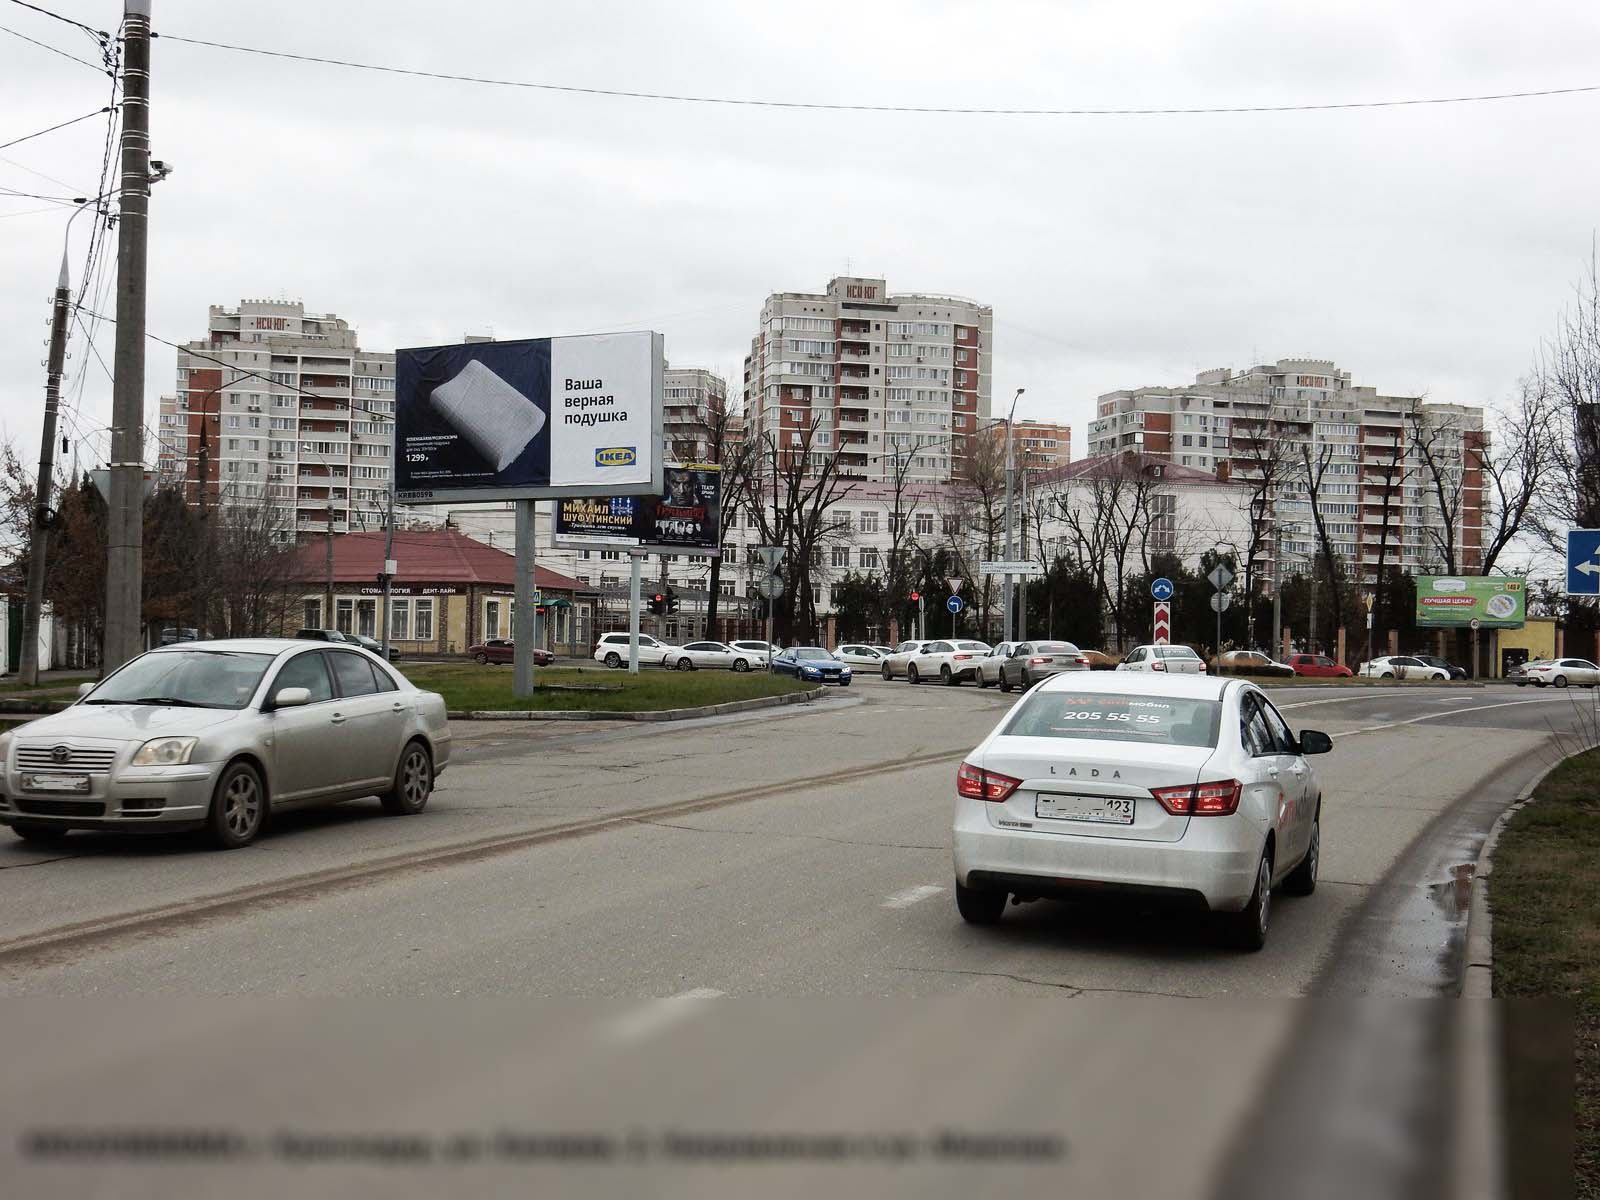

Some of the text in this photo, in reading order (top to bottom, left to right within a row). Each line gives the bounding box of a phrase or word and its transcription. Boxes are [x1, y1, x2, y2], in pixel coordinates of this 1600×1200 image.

[564, 377, 603, 391] Ваша
[564, 393, 615, 409] верная
[564, 411, 629, 427] подушка
[563, 502, 609, 515] МИХАИЛ
[562, 513, 633, 525] ШУФУТИНСКИЙ
[361, 587, 455, 596] СТОМАЛОГИЯ ДЕНТ-ЛАЙН
[1063, 711, 1161, 724] 205 55 55
[1050, 766, 1121, 779] LADA
[1106, 800, 1130, 813] 123
